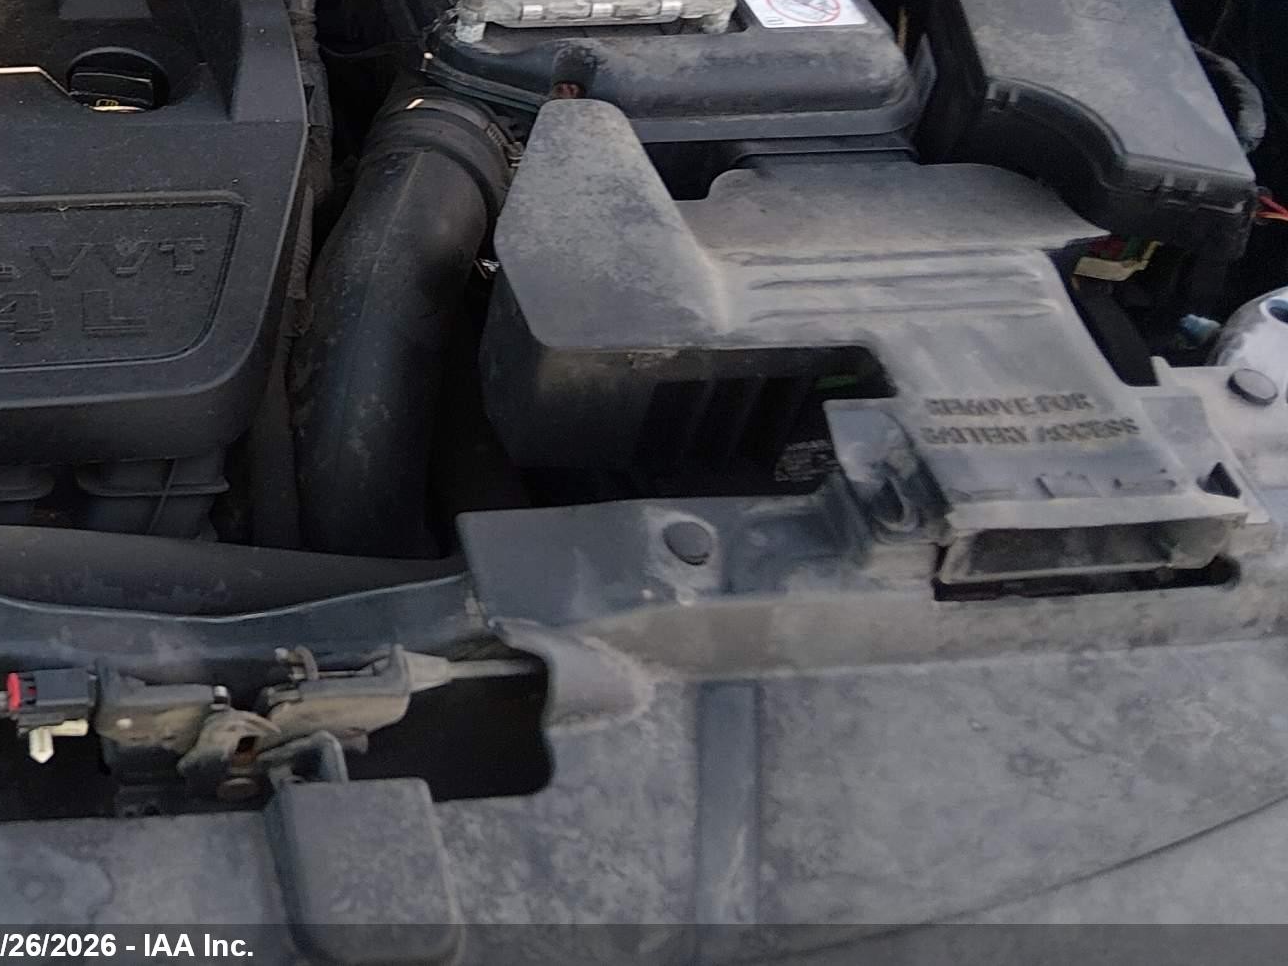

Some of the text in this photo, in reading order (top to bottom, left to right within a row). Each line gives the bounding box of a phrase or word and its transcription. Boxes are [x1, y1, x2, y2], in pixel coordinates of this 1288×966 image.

[27, 237, 206, 279] VVT
[925, 393, 1094, 416] REMOVE FOR
[920, 417, 1140, 445] BATTERY ACCESS
